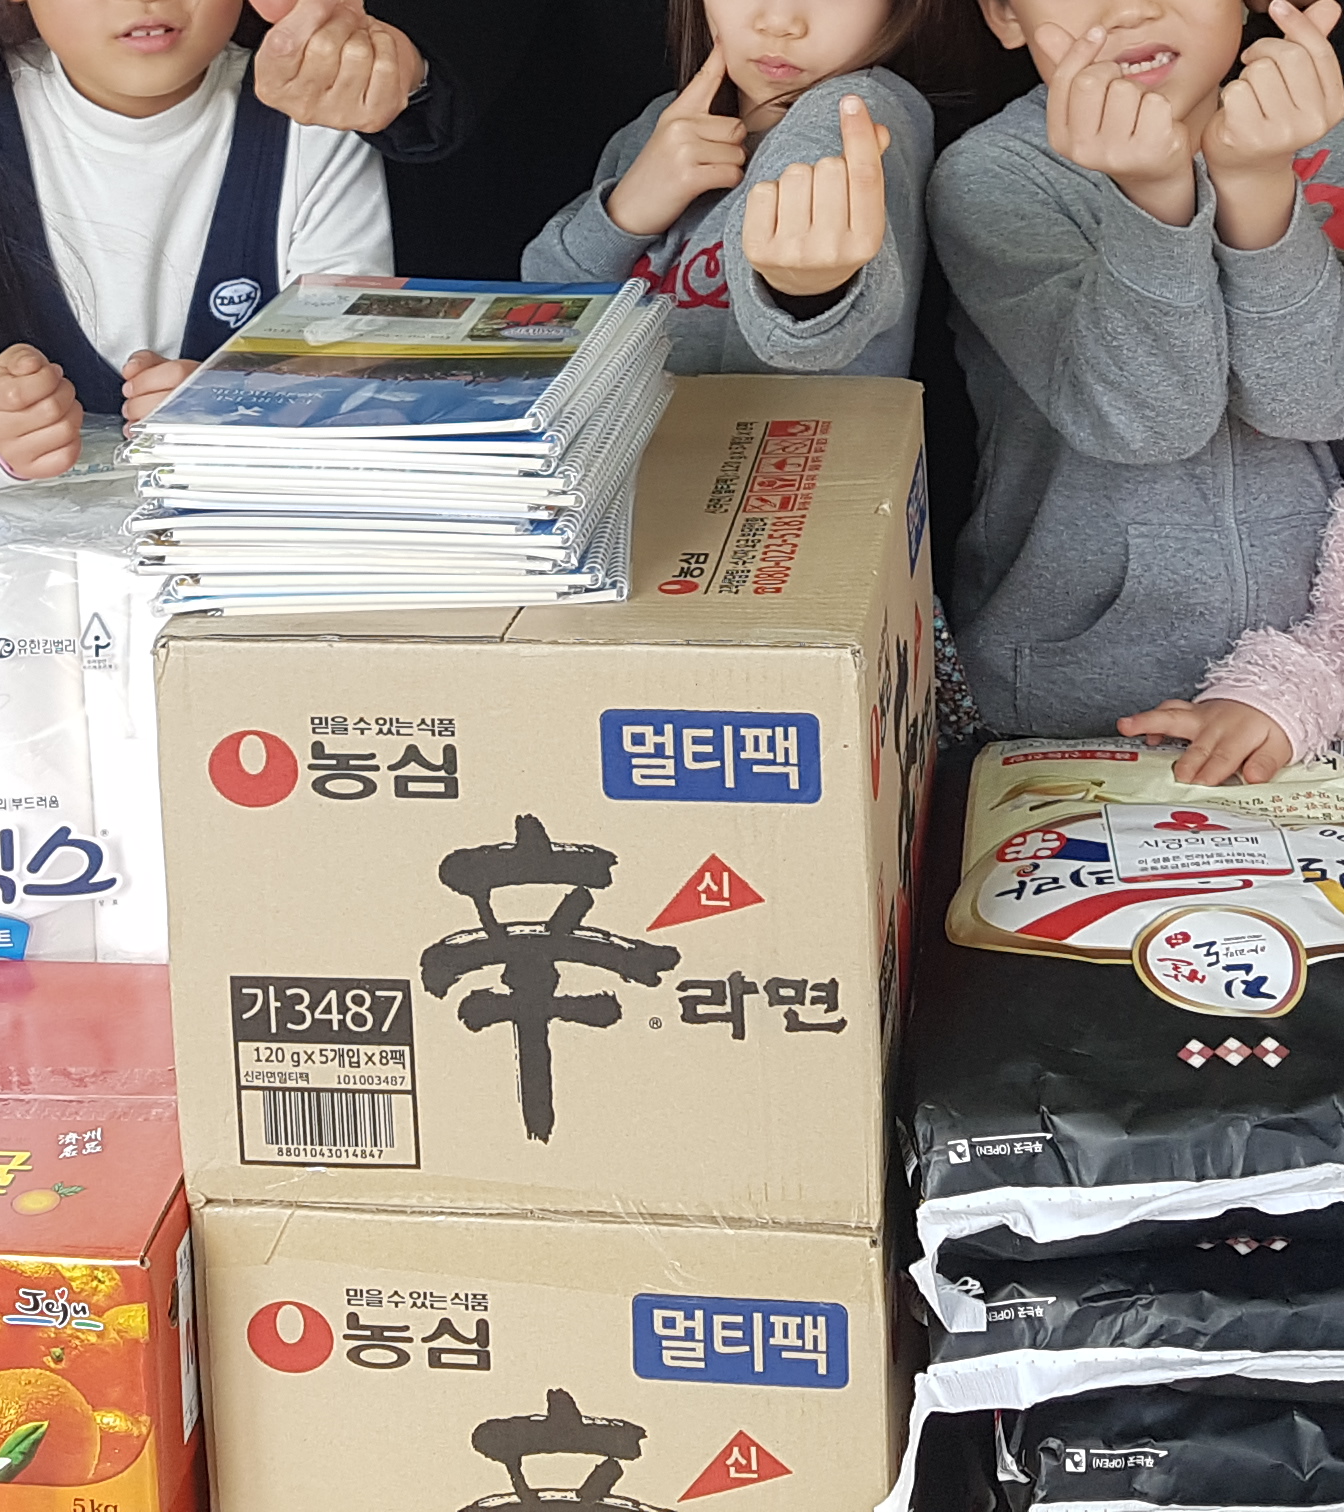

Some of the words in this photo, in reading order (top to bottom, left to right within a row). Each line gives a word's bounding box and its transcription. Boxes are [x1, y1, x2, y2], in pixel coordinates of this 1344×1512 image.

[217, 291, 255, 306] TALK
[752, 514, 807, 586] 080-023-5181
[671, 552, 710, 579] 농심
[18, 639, 76, 654] 유한킴벌리
[310, 715, 349, 735] 믿을
[352, 717, 372, 734] 수
[375, 717, 413, 736] 있는
[416, 717, 456, 737] 식품
[622, 723, 800, 791] 멀티팩
[307, 740, 460, 800] 농심
[11, 795, 59, 809] 부드러움
[698, 870, 732, 908] 신
[420, 813, 681, 1144] 辛
[242, 985, 403, 1033] 가3487
[677, 971, 848, 1039] 라면
[254, 1047, 285, 1063] 120
[243, 1071, 310, 1084] 신라면멀티팩
[337, 1074, 406, 1086] 101003487
[277, 1147, 384, 1159] 8801043014847
[976, 1143, 1010, 1156] (OPEN)
[1013, 1141, 1043, 1154] 푸는곳
[15, 1287, 90, 1328] Jeju
[345, 1288, 384, 1306] 믿을
[387, 1290, 407, 1306] 수
[409, 1290, 449, 1309] 있는
[451, 1291, 490, 1312] 식품
[1017, 1305, 1044, 1318] 푸는곳
[342, 1311, 492, 1372] 농심
[653, 1308, 830, 1375] 멀티팩
[725, 1444, 759, 1480] 신
[1092, 1456, 1125, 1469] (OPEN)
[1126, 1455, 1154, 1468] 푸는곳
